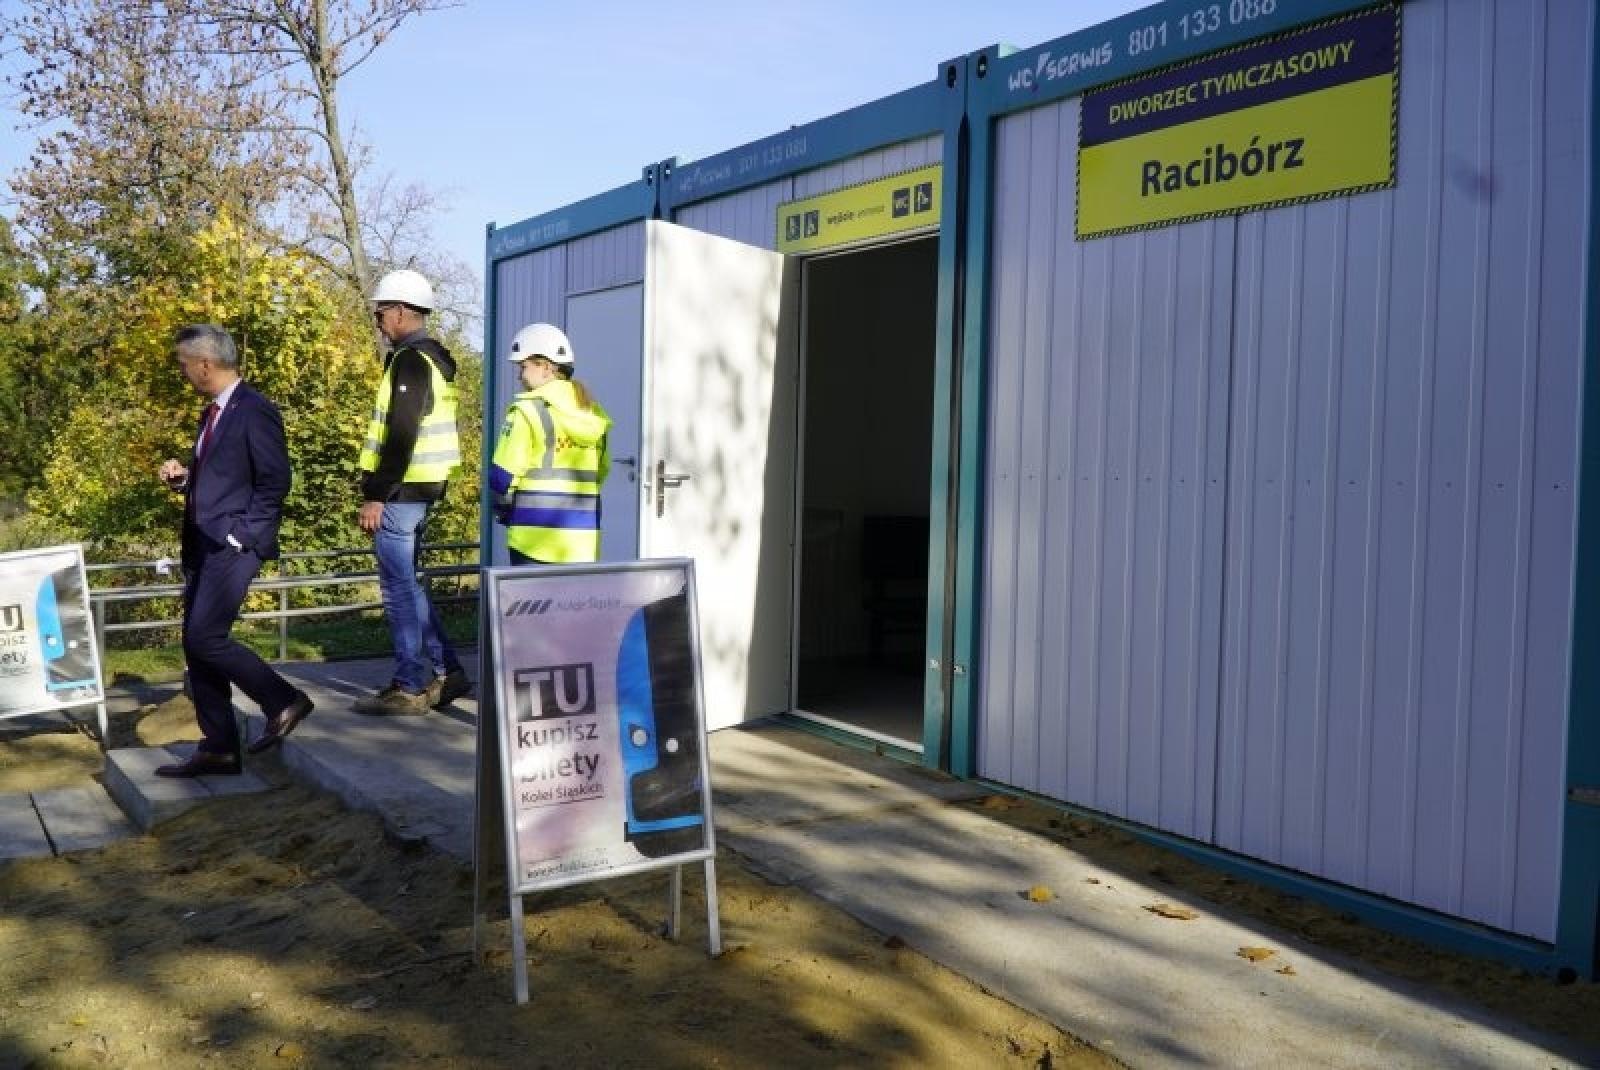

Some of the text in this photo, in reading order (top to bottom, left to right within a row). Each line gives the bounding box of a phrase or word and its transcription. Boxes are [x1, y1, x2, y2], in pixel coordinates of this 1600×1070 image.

[1129, 20, 1167, 56] 801
[1178, 4, 1221, 41] 133
[1109, 40, 1355, 125] DWORZEC TYMCZASOWY
[1141, 136, 1305, 197] Racibórz
[517, 667, 589, 717] TU
[518, 720, 599, 751] kupisz
